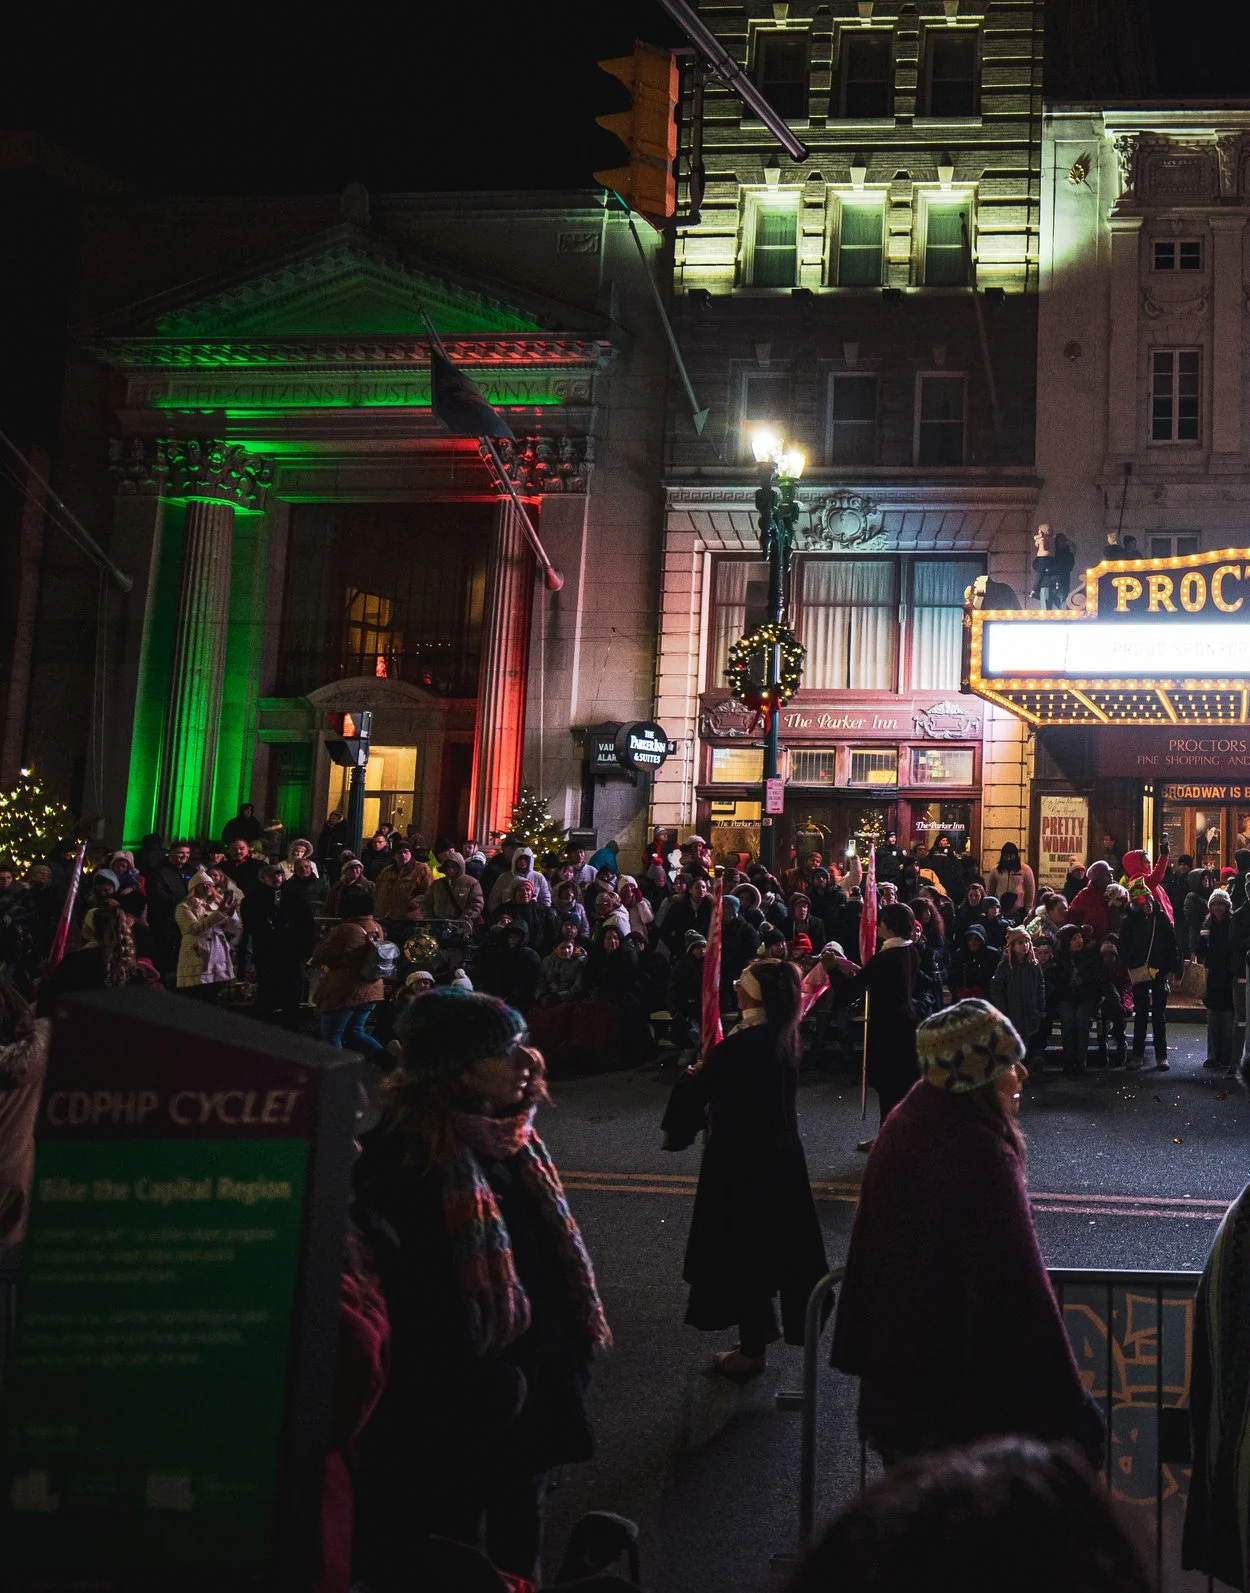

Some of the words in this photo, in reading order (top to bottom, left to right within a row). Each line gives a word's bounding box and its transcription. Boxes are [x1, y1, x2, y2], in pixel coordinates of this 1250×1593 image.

[182, 384, 227, 404] THE
[234, 383, 335, 404] CITIZENS
[341, 383, 414, 404] TRUST
[421, 382, 537, 403] CPANY
[784, 712, 813, 728] The
[817, 712, 867, 729] Parker
[872, 715, 898, 729] Inn
[644, 730, 655, 739] THE
[1169, 739, 1247, 752] PROCTORS
[597, 753, 617, 762] ALAR
[1137, 755, 1158, 765] FINE
[1165, 755, 1220, 766] SHOPPING
[1161, 786, 1227, 798] BROADWAY
[1229, 786, 1241, 798] IS
[915, 821, 928, 829] The
[928, 821, 952, 829] Parker
[953, 821, 965, 829] Inn
[1042, 816, 1085, 836] PRETTY
[1042, 836, 1083, 853] WOMAN
[46, 1090, 159, 1126] CDPHP
[168, 1088, 305, 1125] CYCLE!
[133, 1175, 213, 1207] Capital
[215, 1174, 293, 1206] Region
